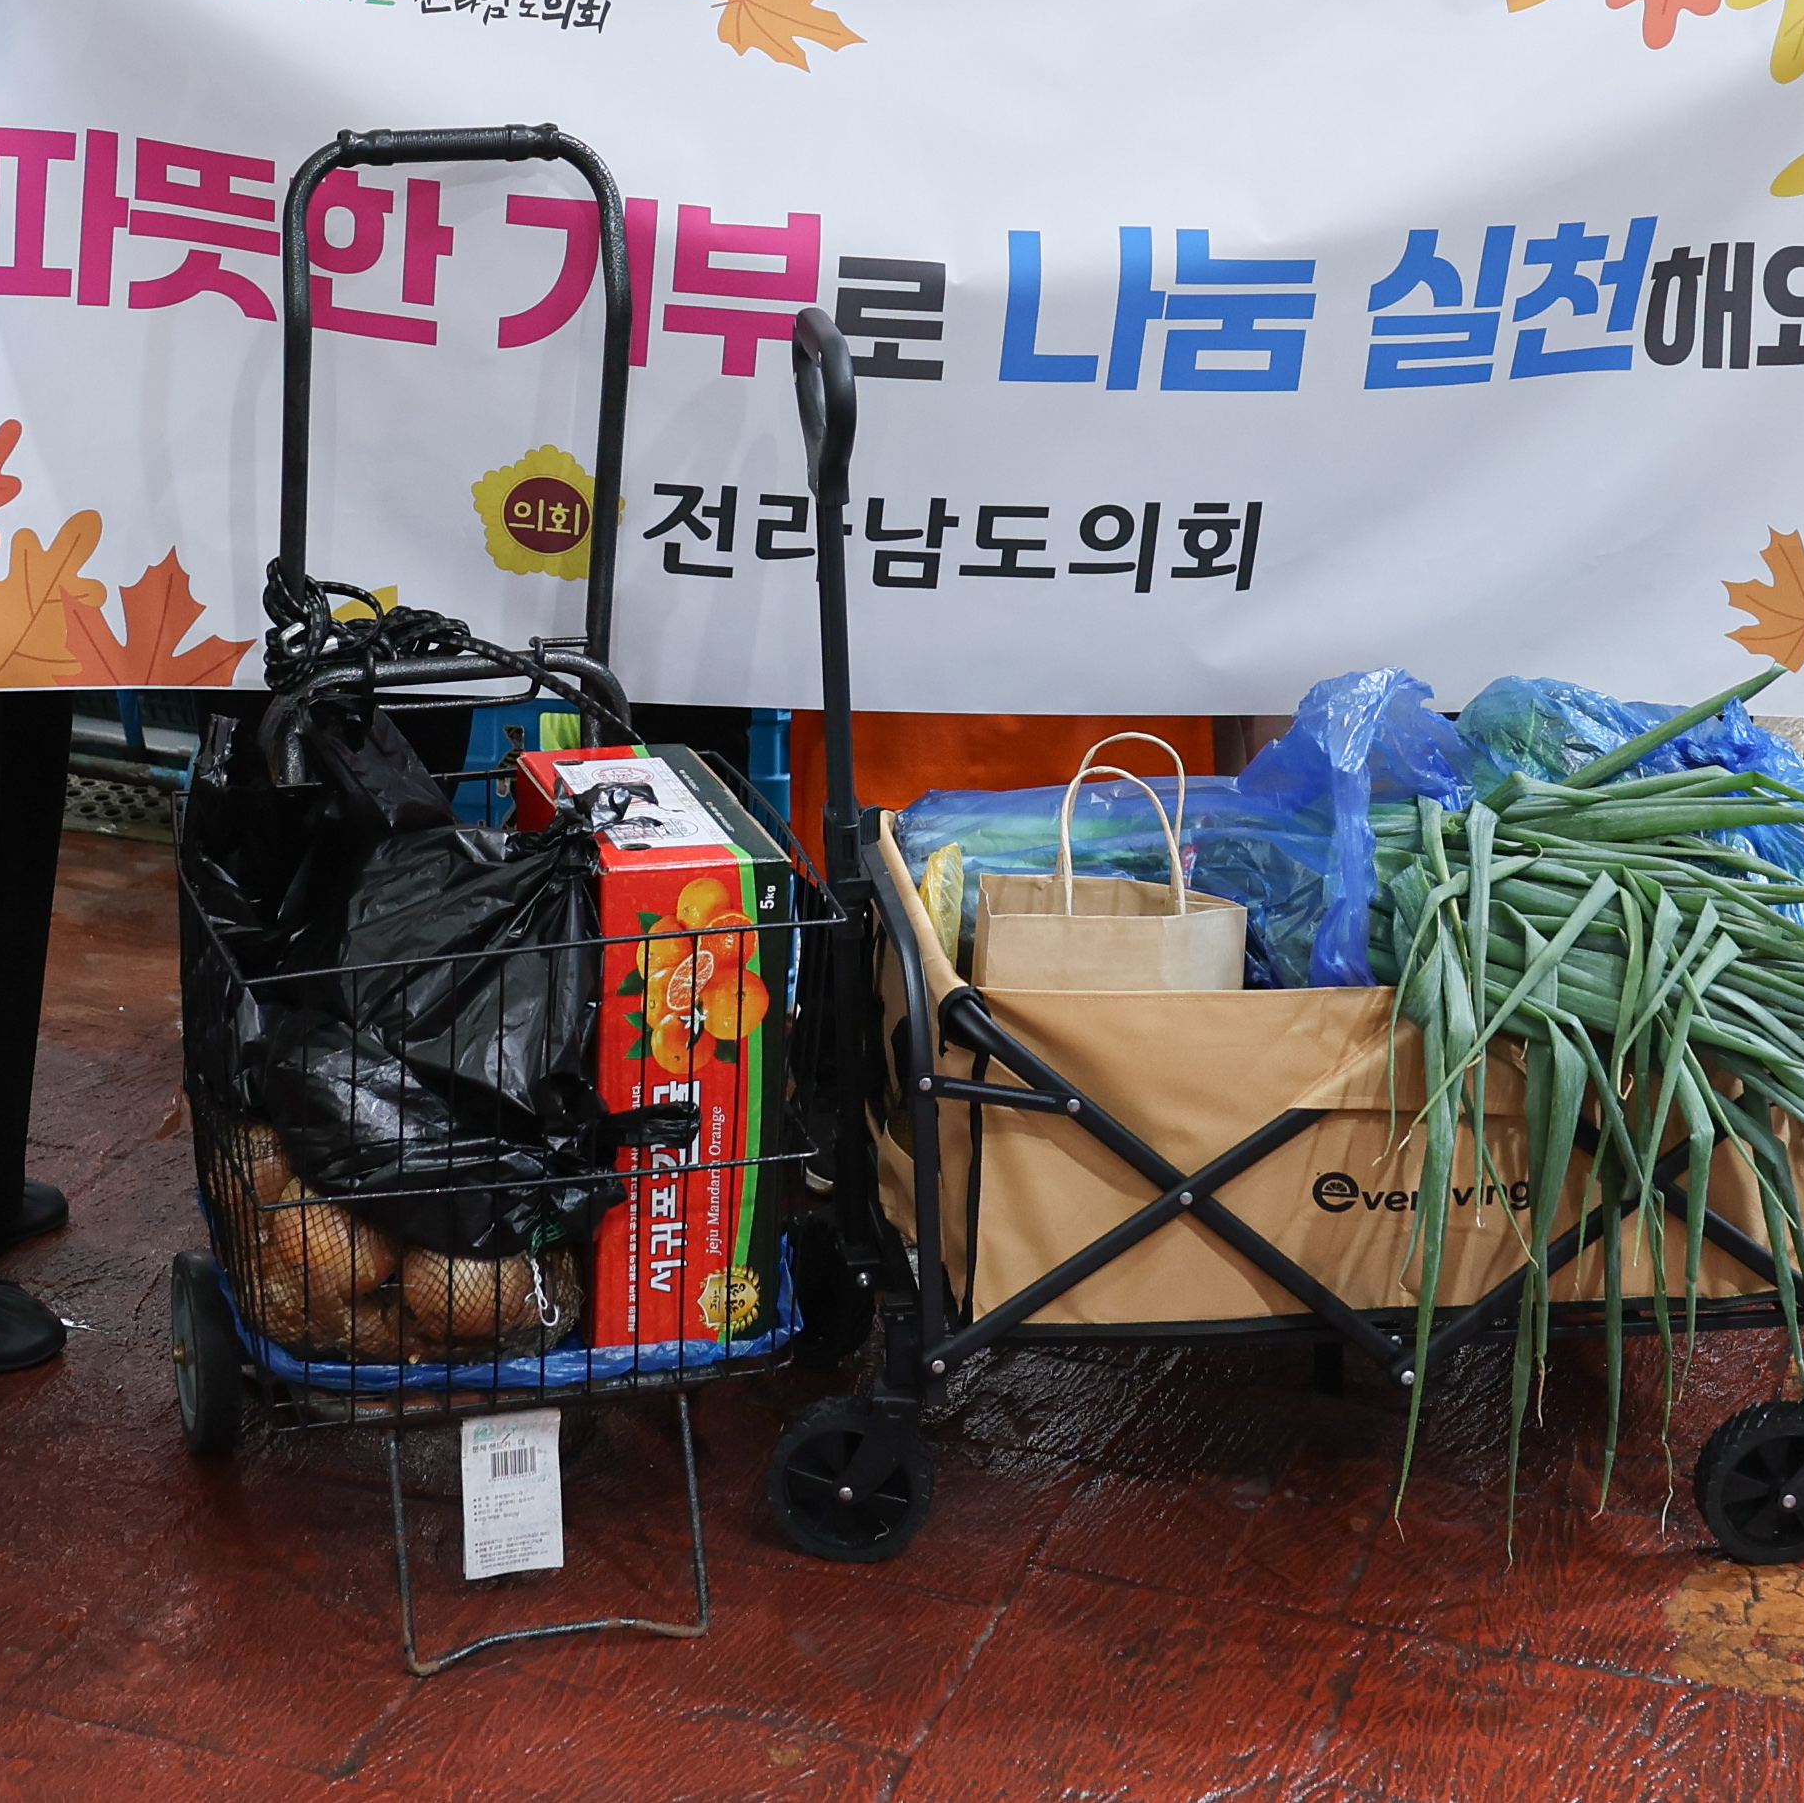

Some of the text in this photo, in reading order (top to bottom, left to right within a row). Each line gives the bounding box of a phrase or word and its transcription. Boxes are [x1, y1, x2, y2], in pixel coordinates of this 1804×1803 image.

[496, 193, 947, 382] 기부로
[998, 225, 1317, 392] 나눔
[642, 482, 1264, 595] 전라남도의회
[759, 884, 777, 911] 5kg
[708, 1105, 726, 1156] Orange
